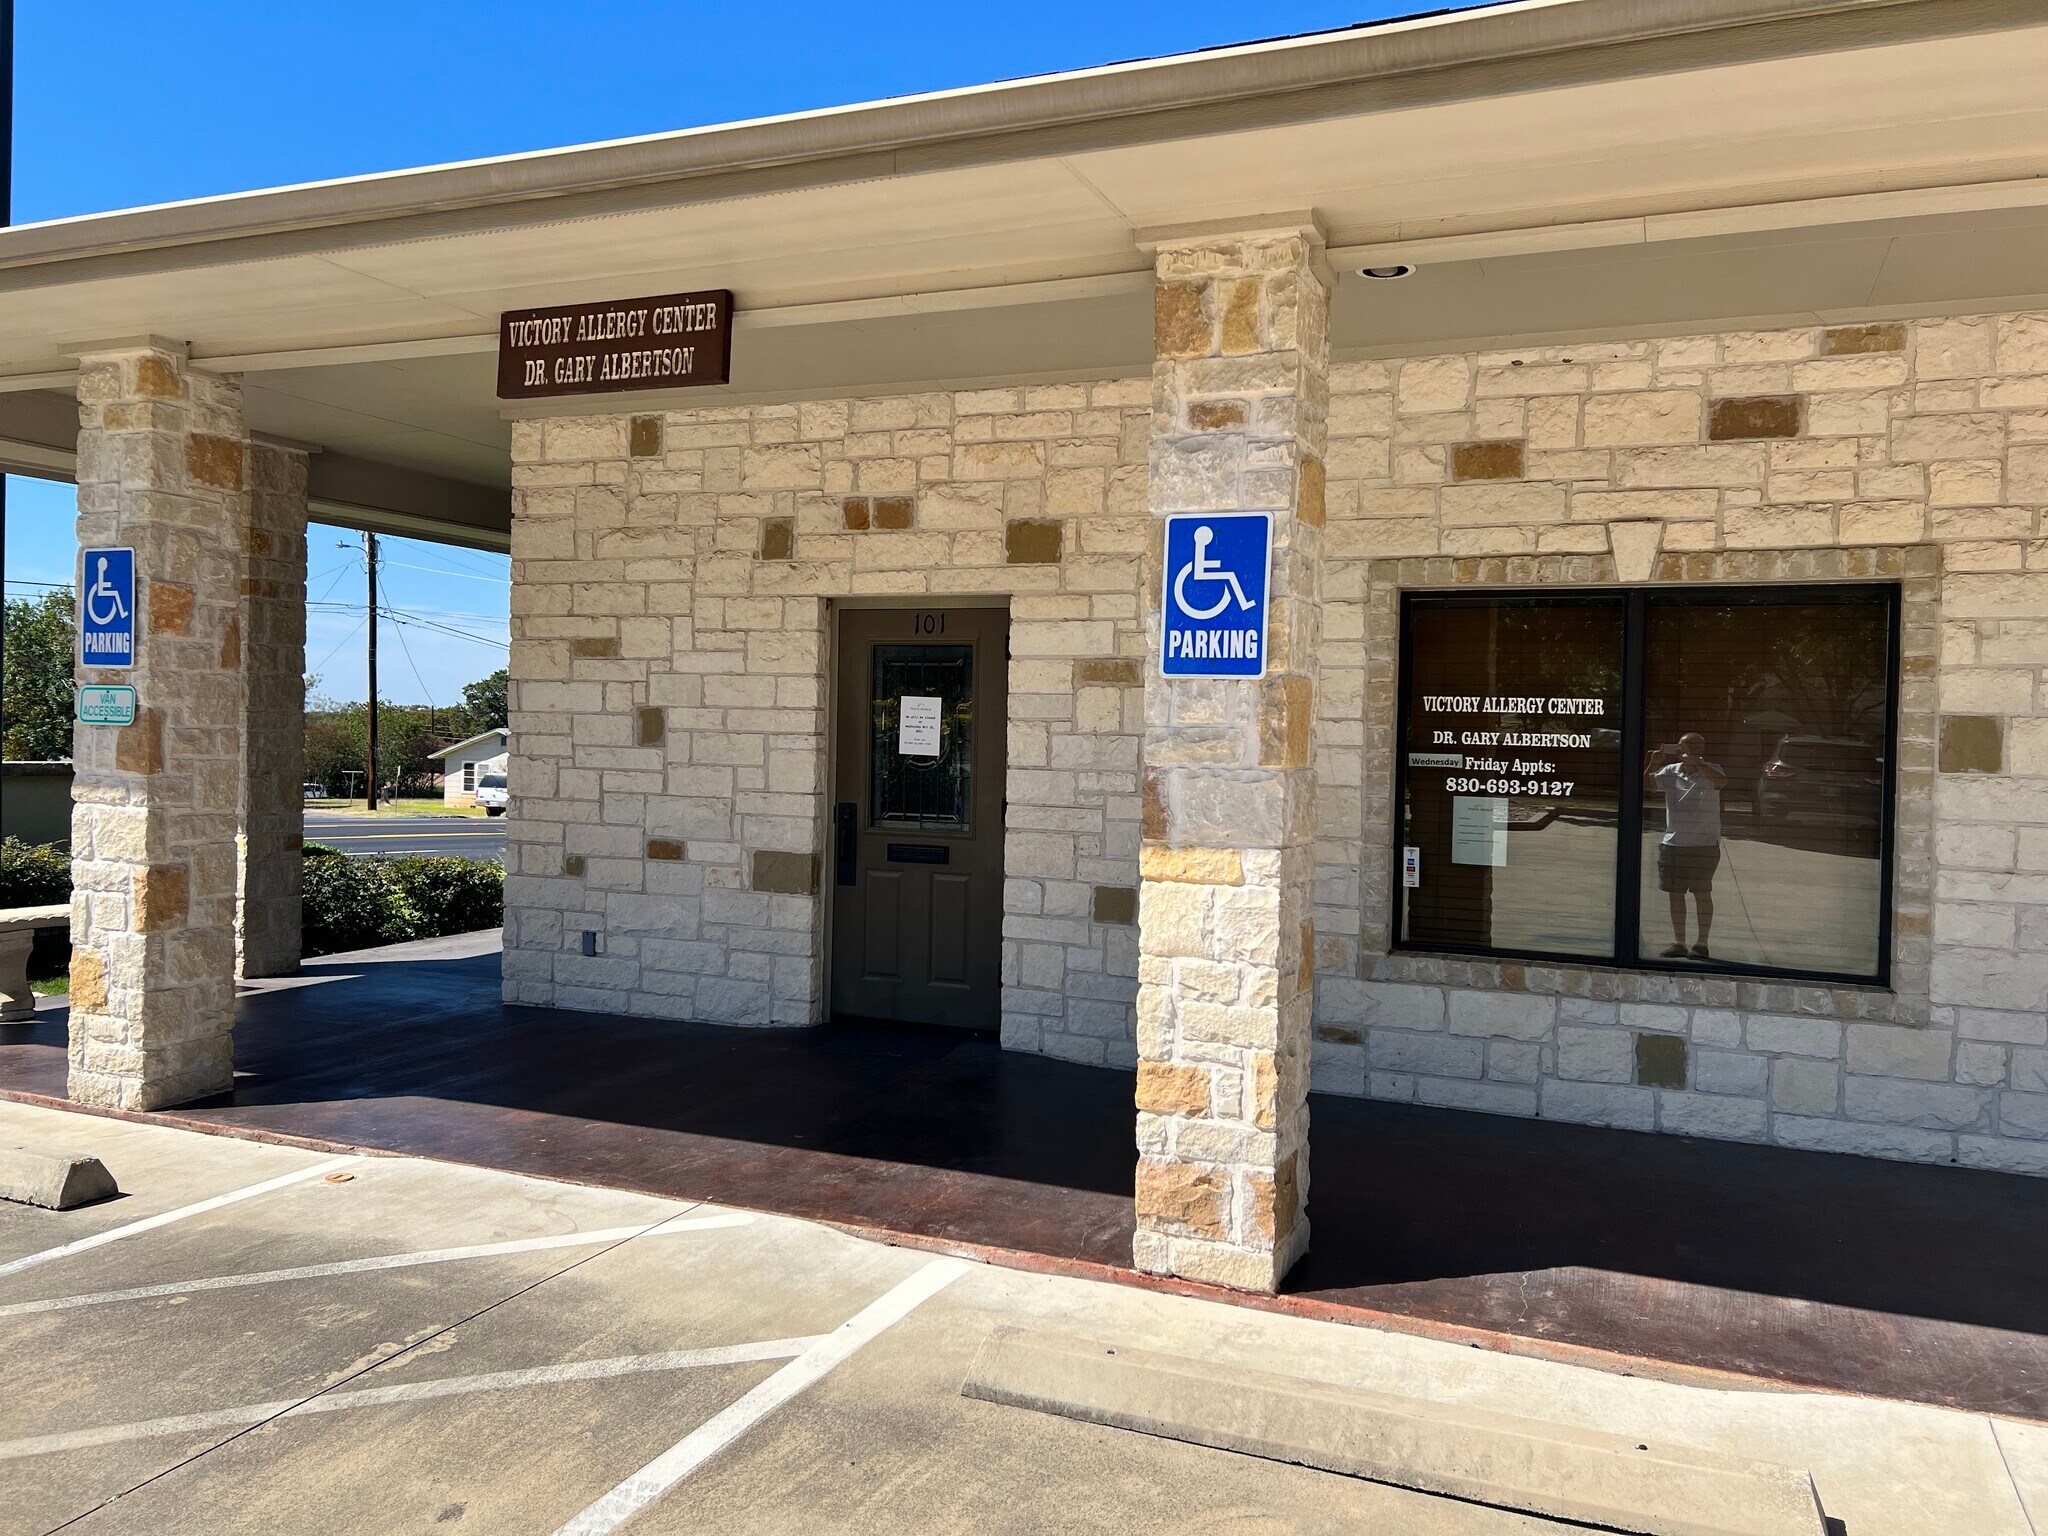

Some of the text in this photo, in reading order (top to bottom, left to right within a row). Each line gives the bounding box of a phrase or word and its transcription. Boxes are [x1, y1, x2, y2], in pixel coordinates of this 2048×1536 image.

[509, 302, 717, 348] VICTORY ALLERGY CENTER
[524, 347, 695, 387] DR. GARY ALBERTSON
[914, 612, 945, 635] 101
[85, 632, 130, 653] PARKING
[1168, 629, 1258, 659] PARKING
[100, 693, 116, 704] VAN
[1423, 695, 1605, 716] VICTORY ALLERGY CENTER
[83, 705, 131, 717] ACCESSIBLE
[1433, 730, 1592, 748] DR. GARY ALBERTSON
[1411, 756, 1556, 776] Wednesday Friday Appts:
[1445, 777, 1575, 796] 830-693-9127
